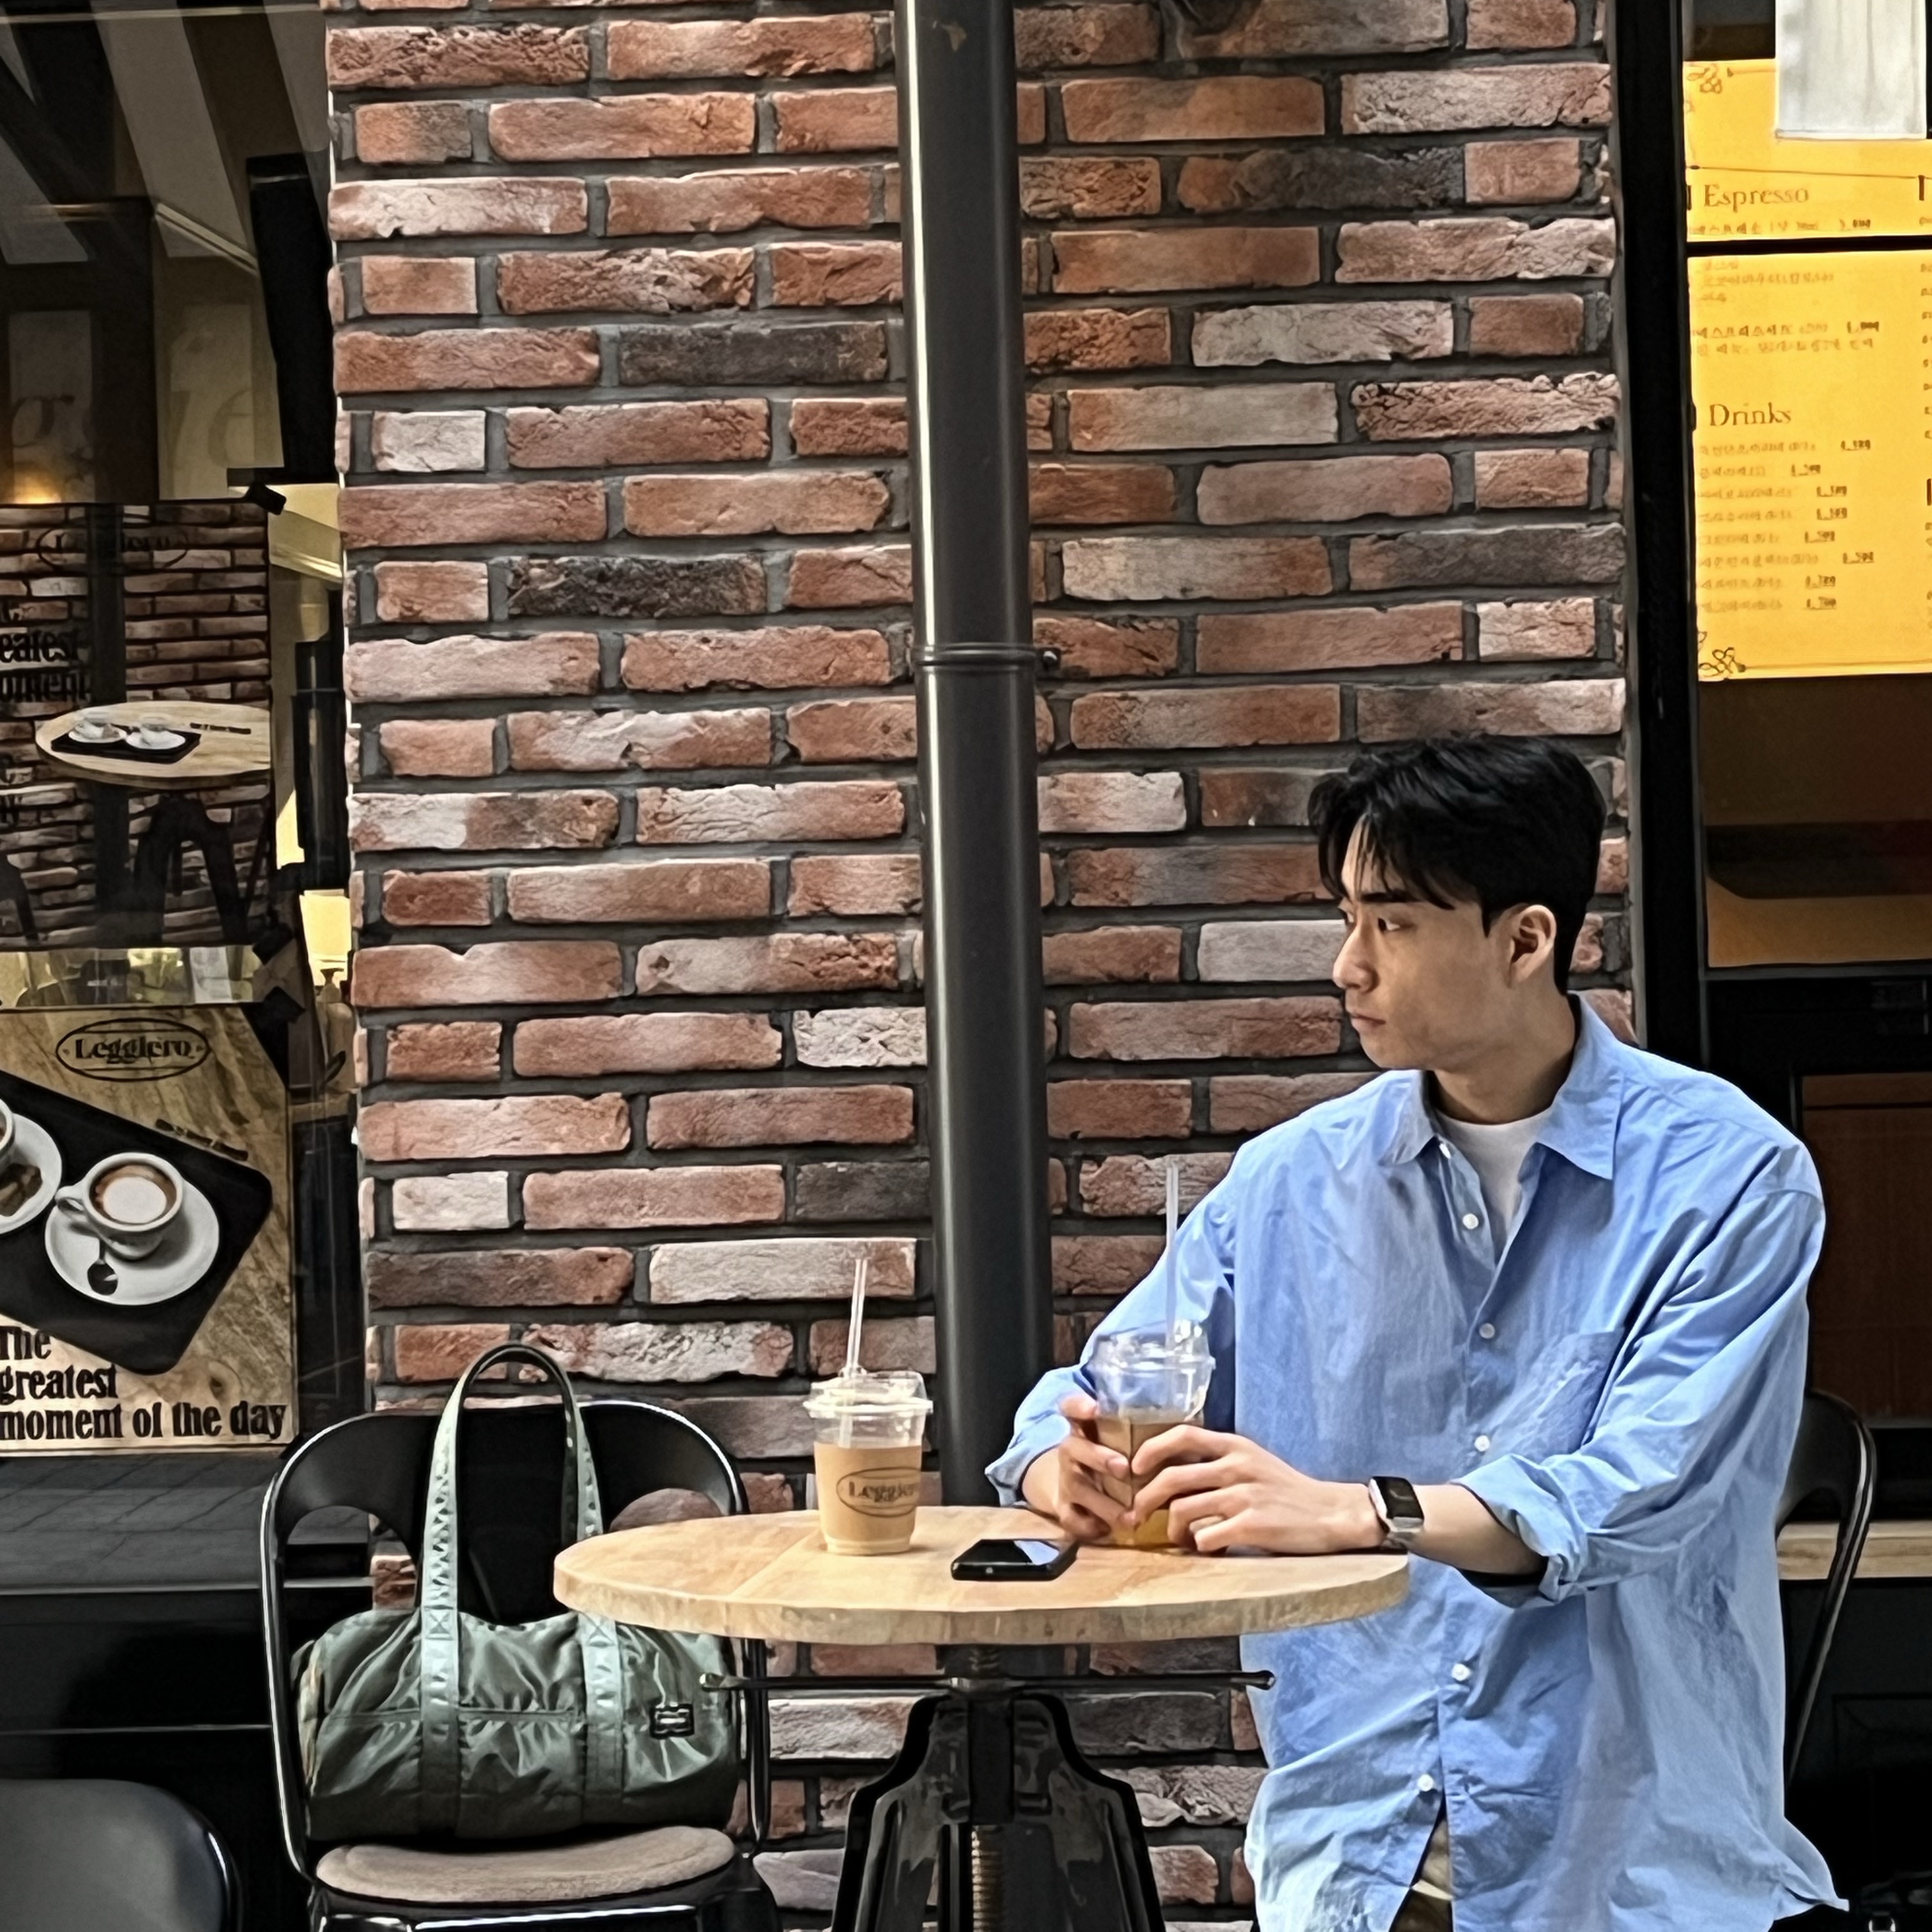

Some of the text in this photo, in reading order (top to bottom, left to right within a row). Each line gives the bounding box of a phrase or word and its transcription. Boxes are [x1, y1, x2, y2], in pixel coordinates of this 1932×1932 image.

[1704, 183, 1809, 213] Espresso
[1710, 402, 1791, 426] Drinks
[75, 1036, 193, 1064] Leggiero
[0, 1363, 119, 1406] greatest
[0, 1400, 288, 1441] moment of the day
